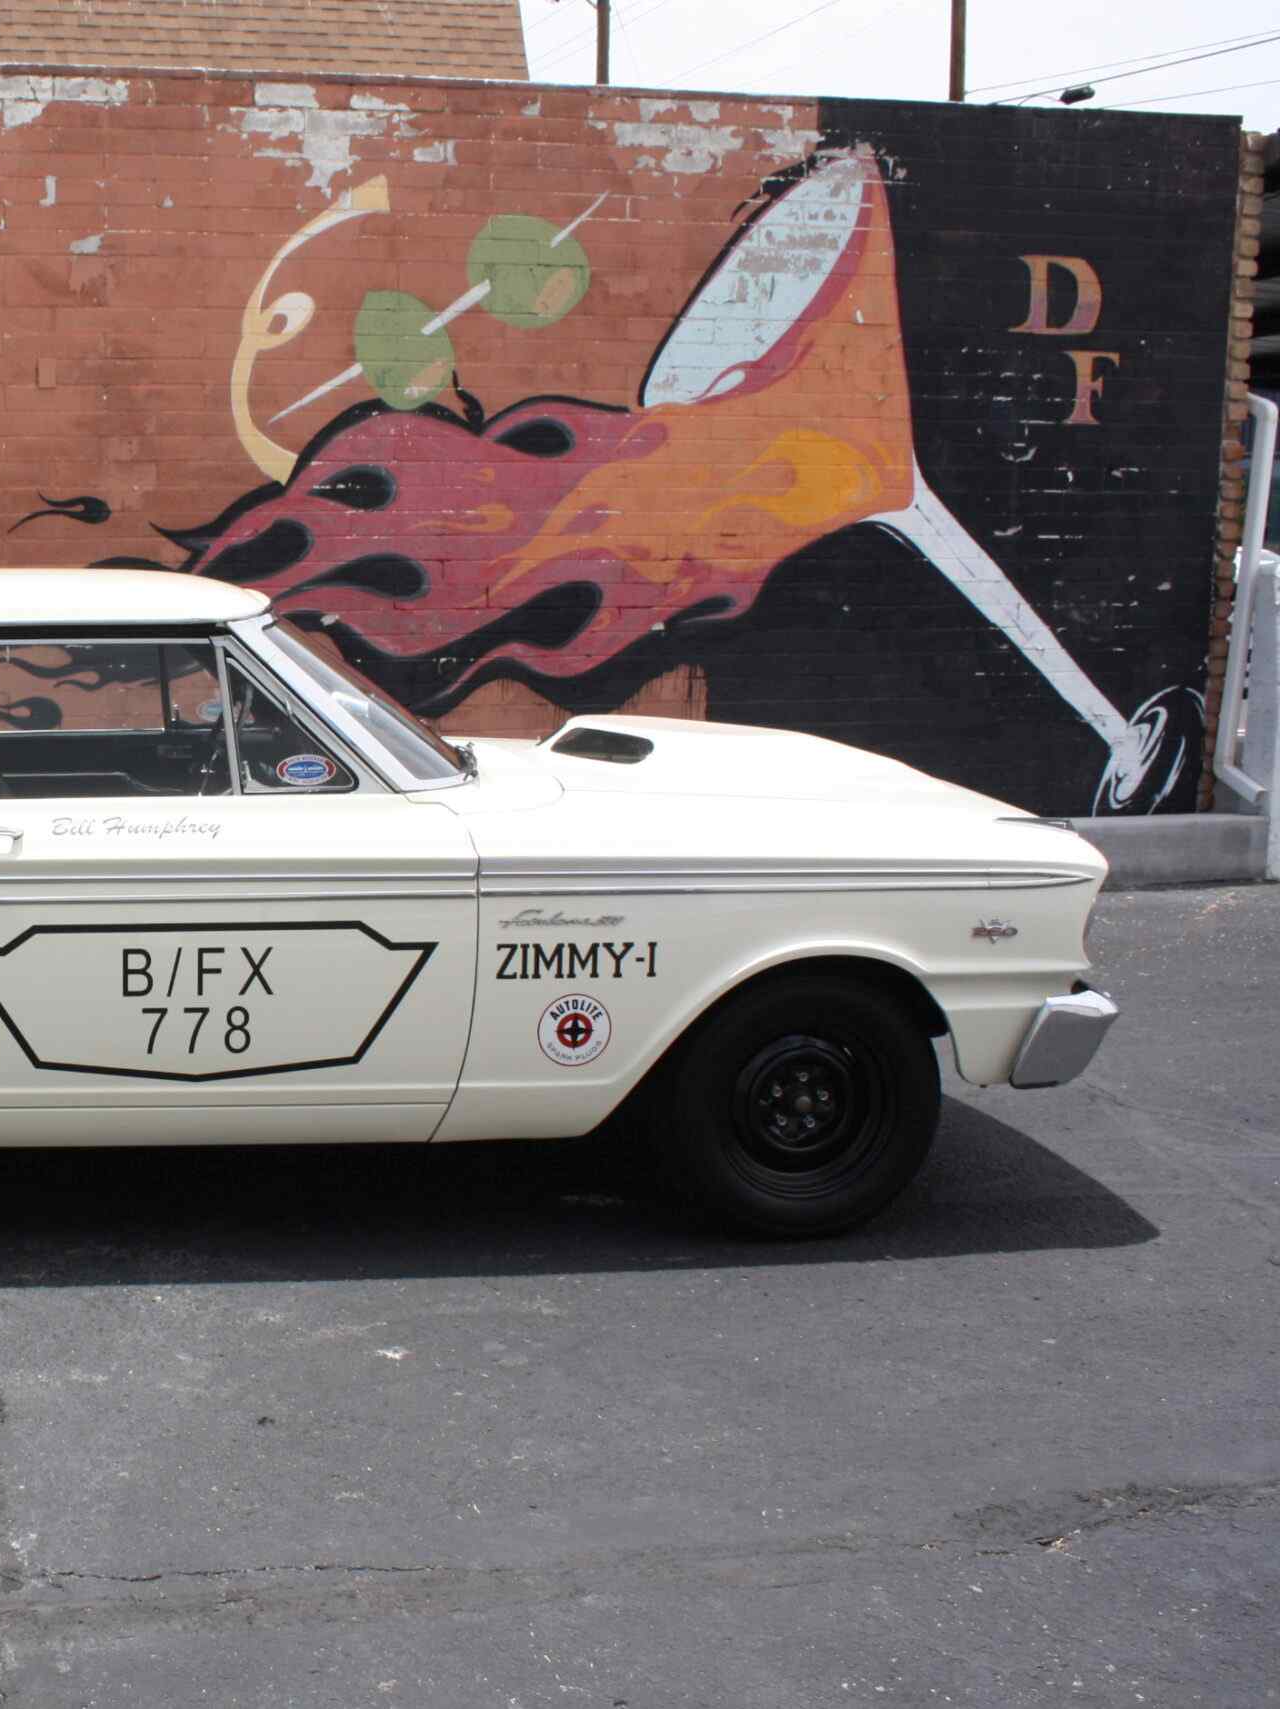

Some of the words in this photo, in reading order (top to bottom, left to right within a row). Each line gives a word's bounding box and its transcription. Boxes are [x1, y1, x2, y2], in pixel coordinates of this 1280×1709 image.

[1008, 255, 1102, 335] D
[1063, 350, 1120, 425] F
[51, 817, 95, 836] Bill
[102, 816, 221, 840] Humphrey
[121, 946, 274, 998] B/FX
[495, 941, 658, 980] ZIMMY-I
[141, 1005, 251, 1055] 778
[549, 998, 603, 1021] AUTOLITE
